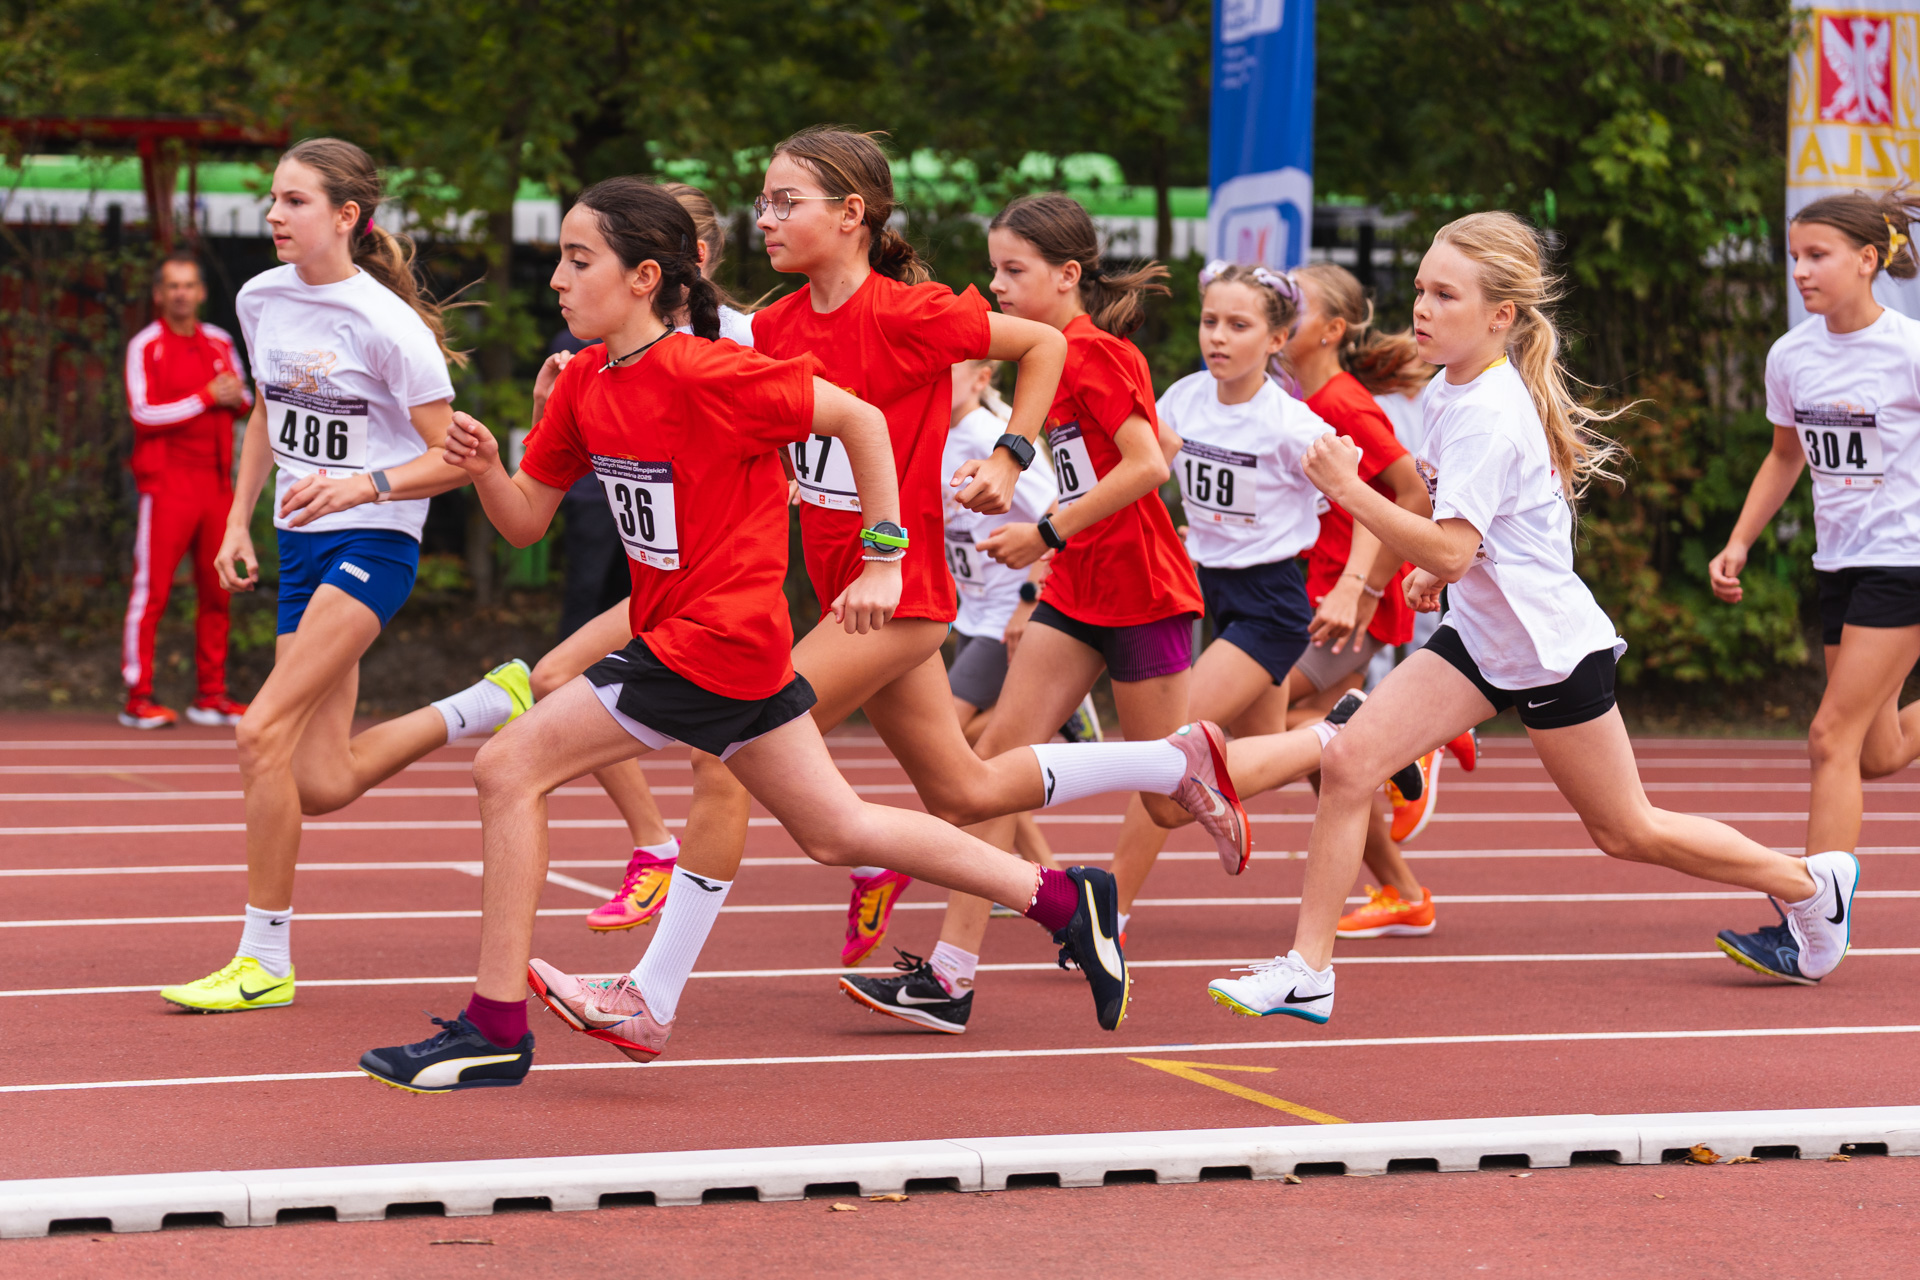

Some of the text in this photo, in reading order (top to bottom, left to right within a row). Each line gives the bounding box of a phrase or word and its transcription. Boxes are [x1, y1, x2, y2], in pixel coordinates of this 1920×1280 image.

[279, 409, 348, 460] 486
[795, 434, 832, 483] 47
[1805, 430, 1867, 469] 304
[1185, 459, 1234, 507] 159
[599, 479, 655, 542] 36
[339, 561, 371, 583] PUMA
